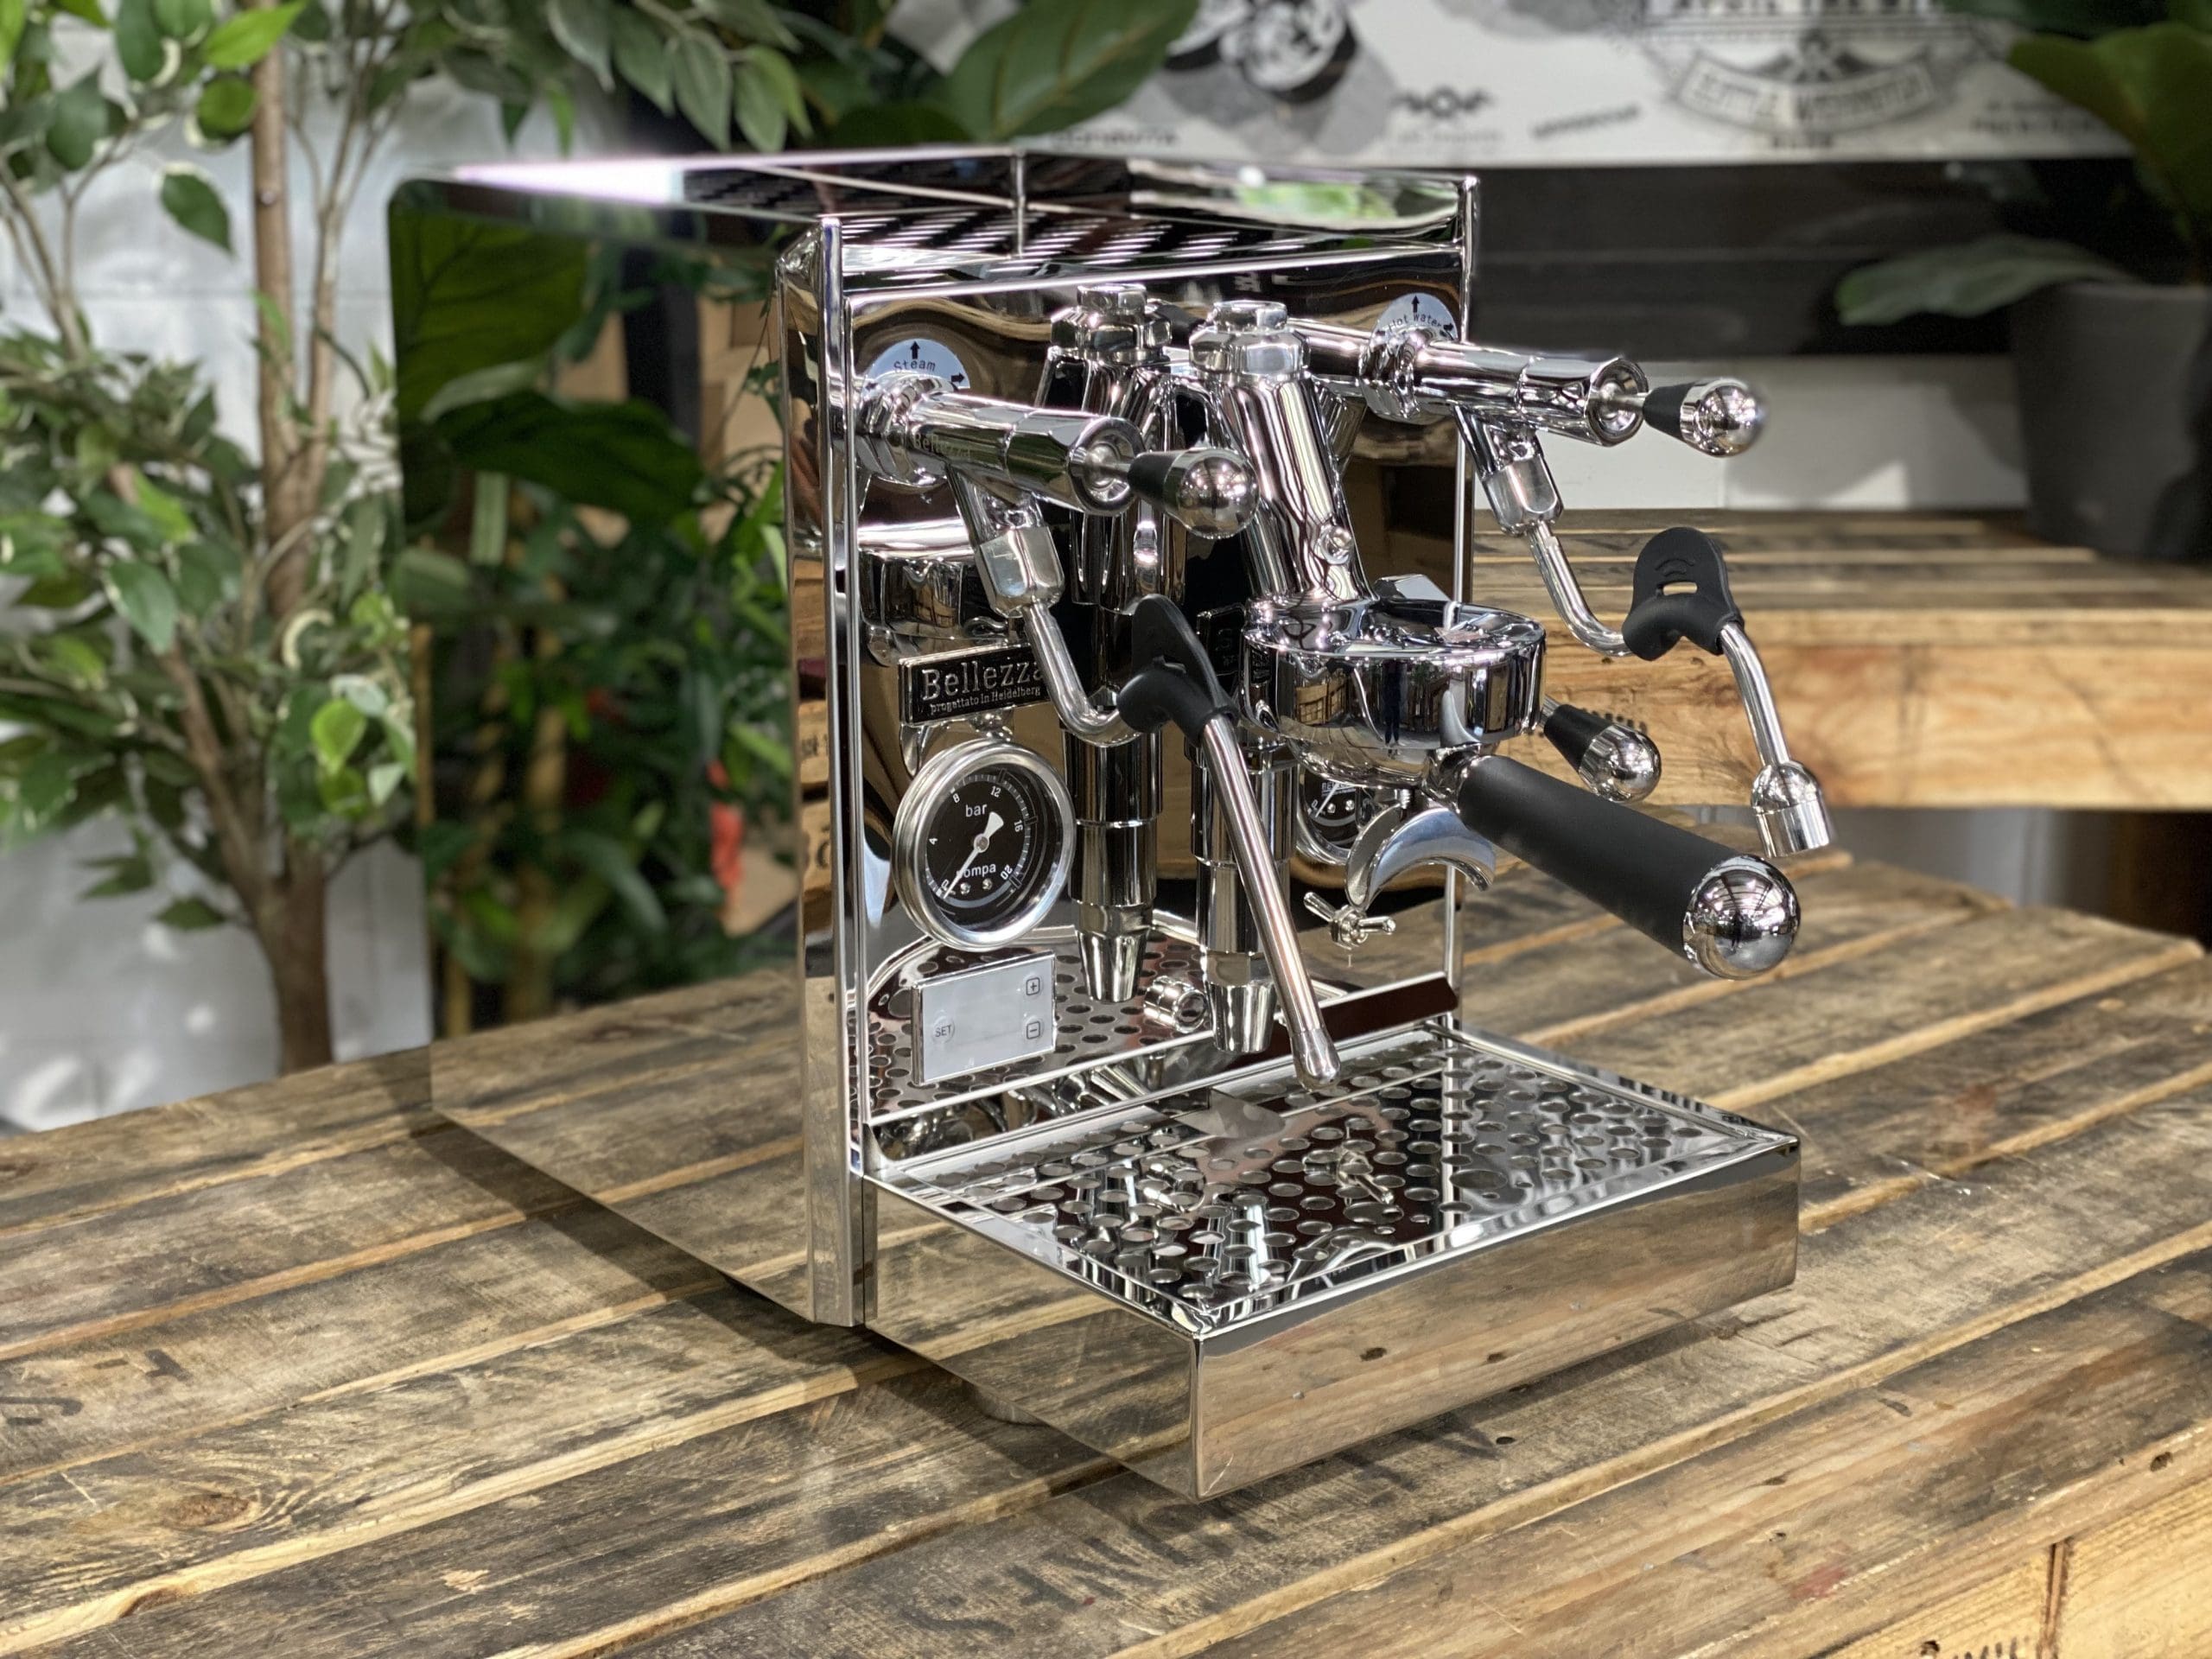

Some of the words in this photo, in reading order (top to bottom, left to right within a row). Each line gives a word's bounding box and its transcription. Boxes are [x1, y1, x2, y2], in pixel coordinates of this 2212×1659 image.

[930, 696, 980, 715] progettato
[992, 687, 1040, 702] Heidelberg
[990, 786, 1001, 798] 12
[953, 793, 960, 804] 8
[965, 804, 988, 817] bar
[1014, 819, 1023, 833] 16
[929, 837, 938, 846] 4
[1000, 865, 1013, 880] 20
[936, 1026, 951, 1037] SET
